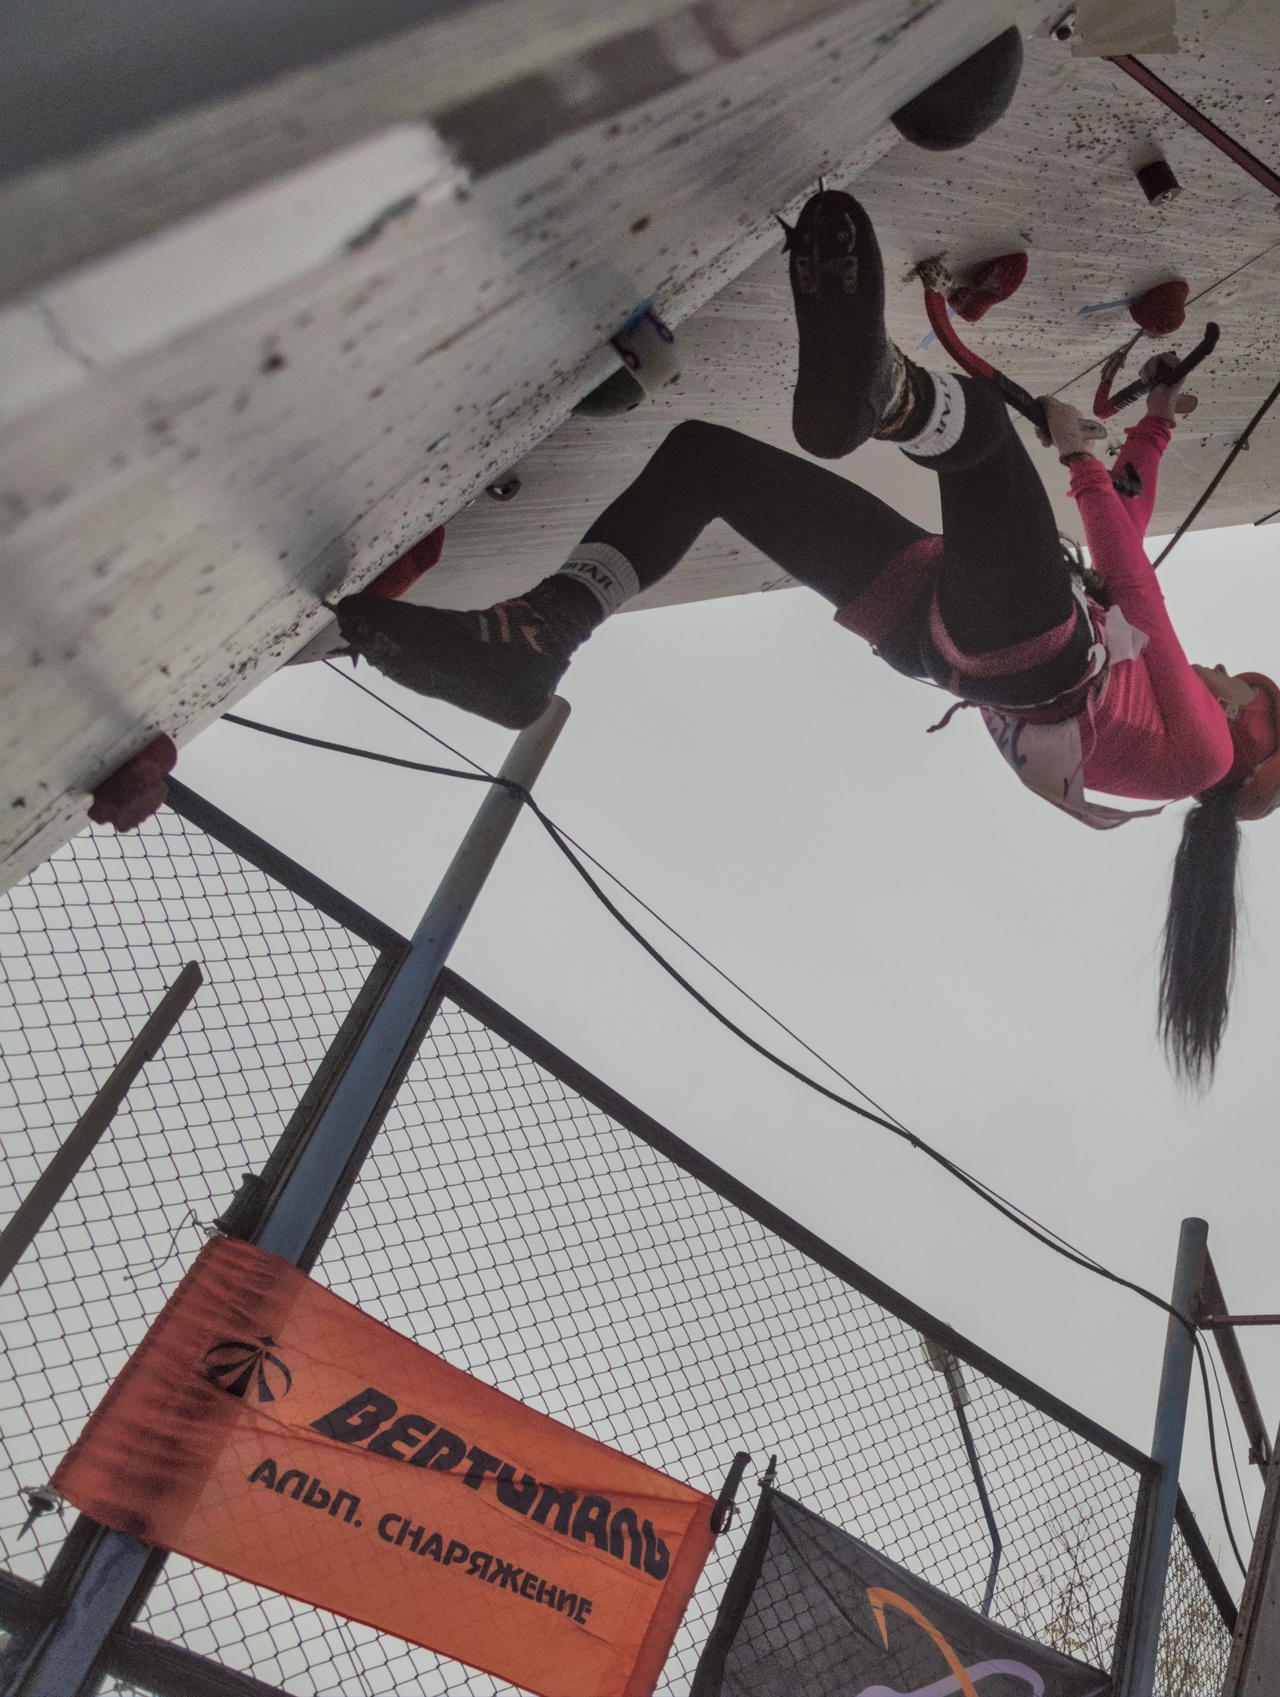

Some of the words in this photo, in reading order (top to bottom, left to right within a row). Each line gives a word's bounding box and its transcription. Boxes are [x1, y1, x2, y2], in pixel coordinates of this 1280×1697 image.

[246, 1457, 363, 1529] АЛЬП.
[376, 1512, 594, 1626] СНАРЯЖЕНИЕ
[308, 1386, 671, 1582] ВЕРТИКАЛЬ
